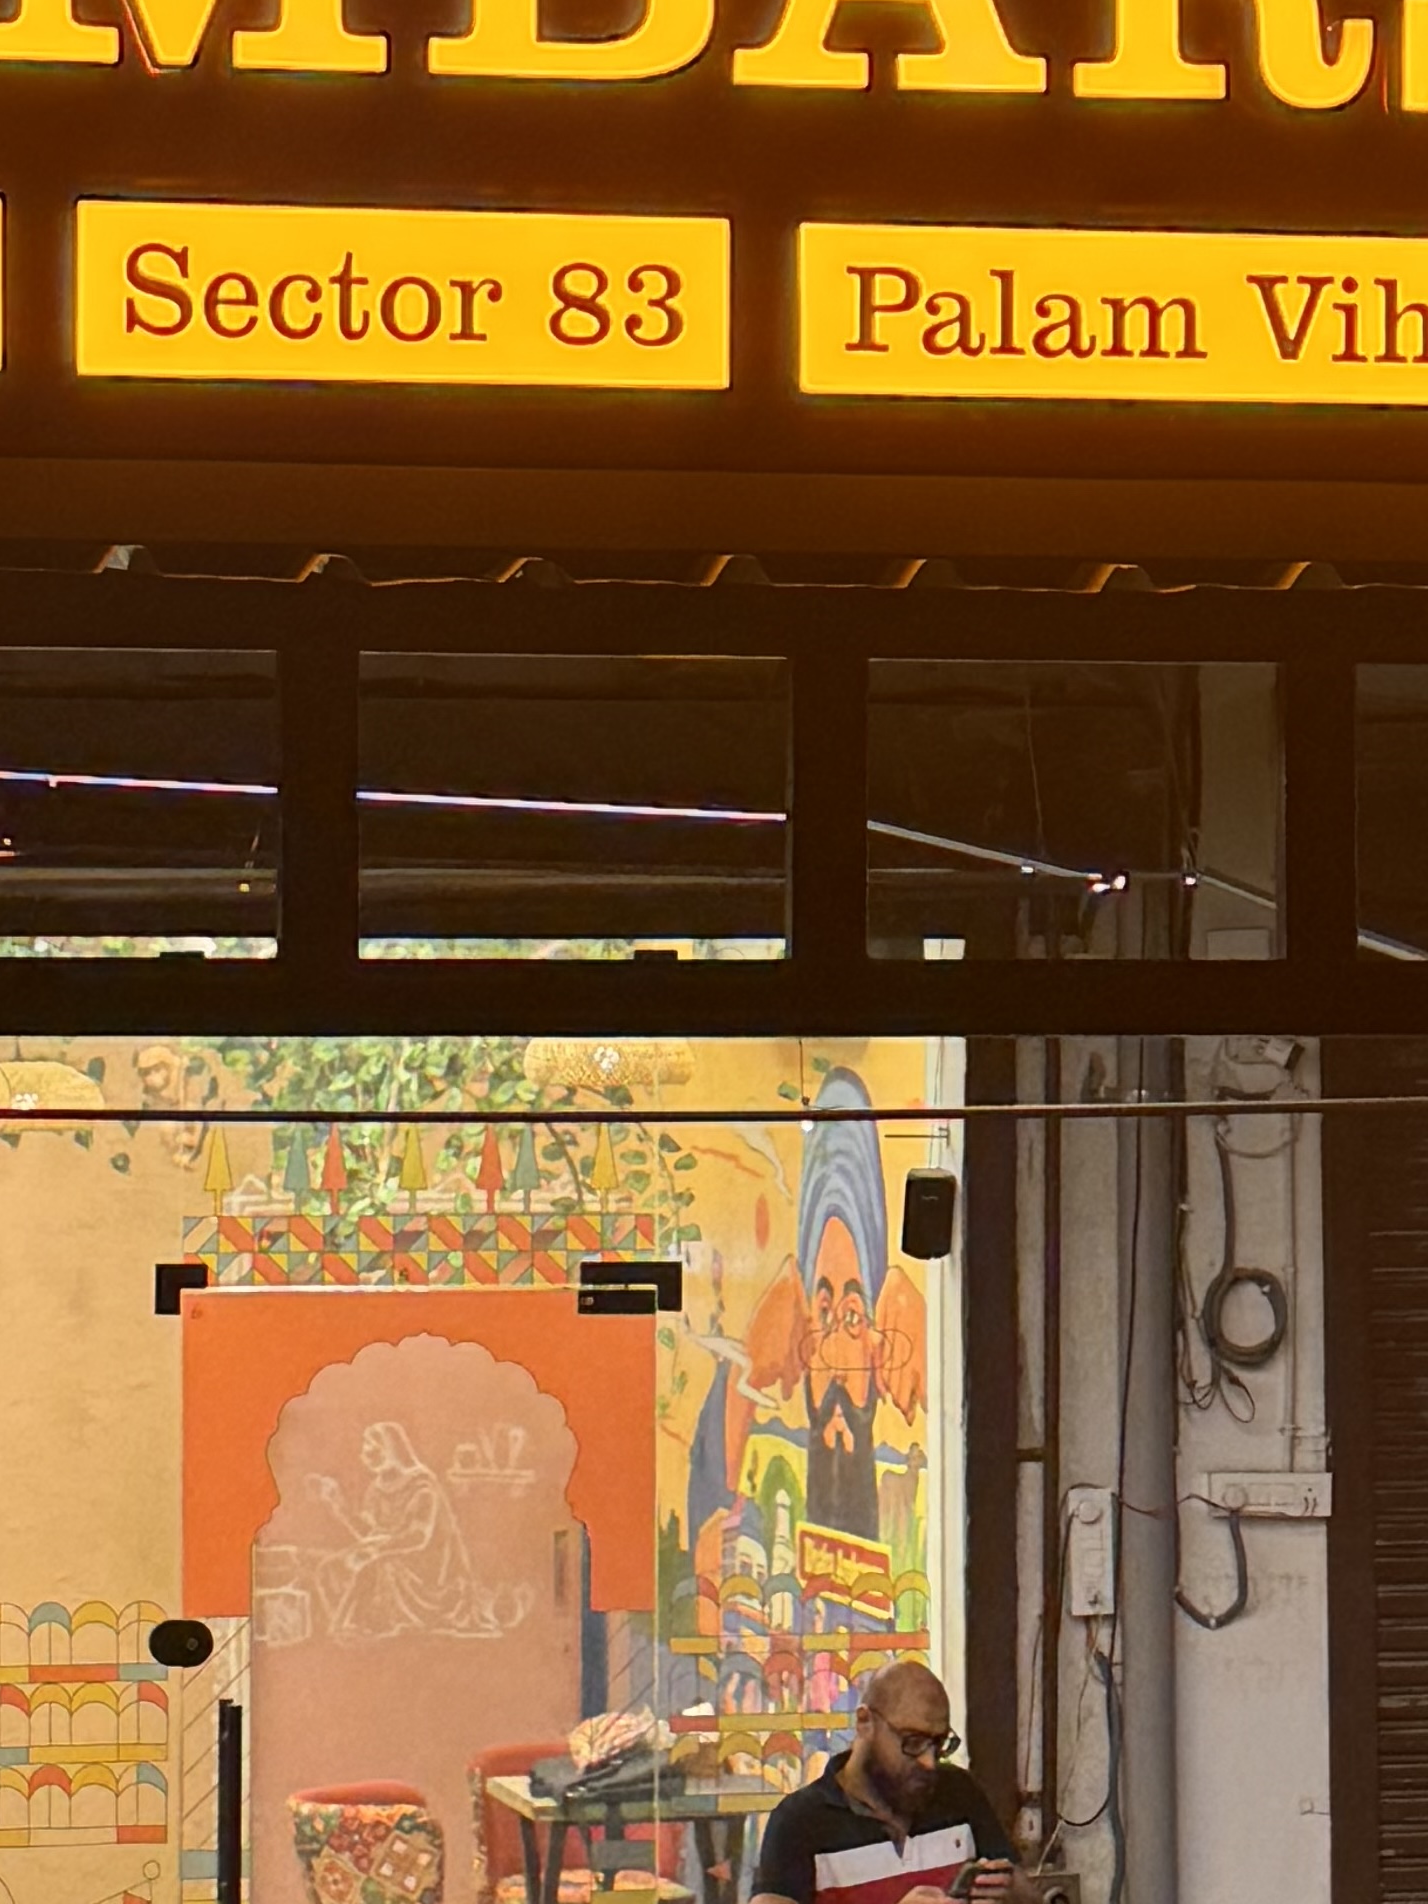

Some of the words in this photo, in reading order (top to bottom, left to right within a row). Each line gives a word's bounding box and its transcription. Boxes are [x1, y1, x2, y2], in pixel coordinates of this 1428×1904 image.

[123, 241, 505, 345] Sector
[546, 259, 686, 349] 83
[842, 264, 1211, 361] Palam
